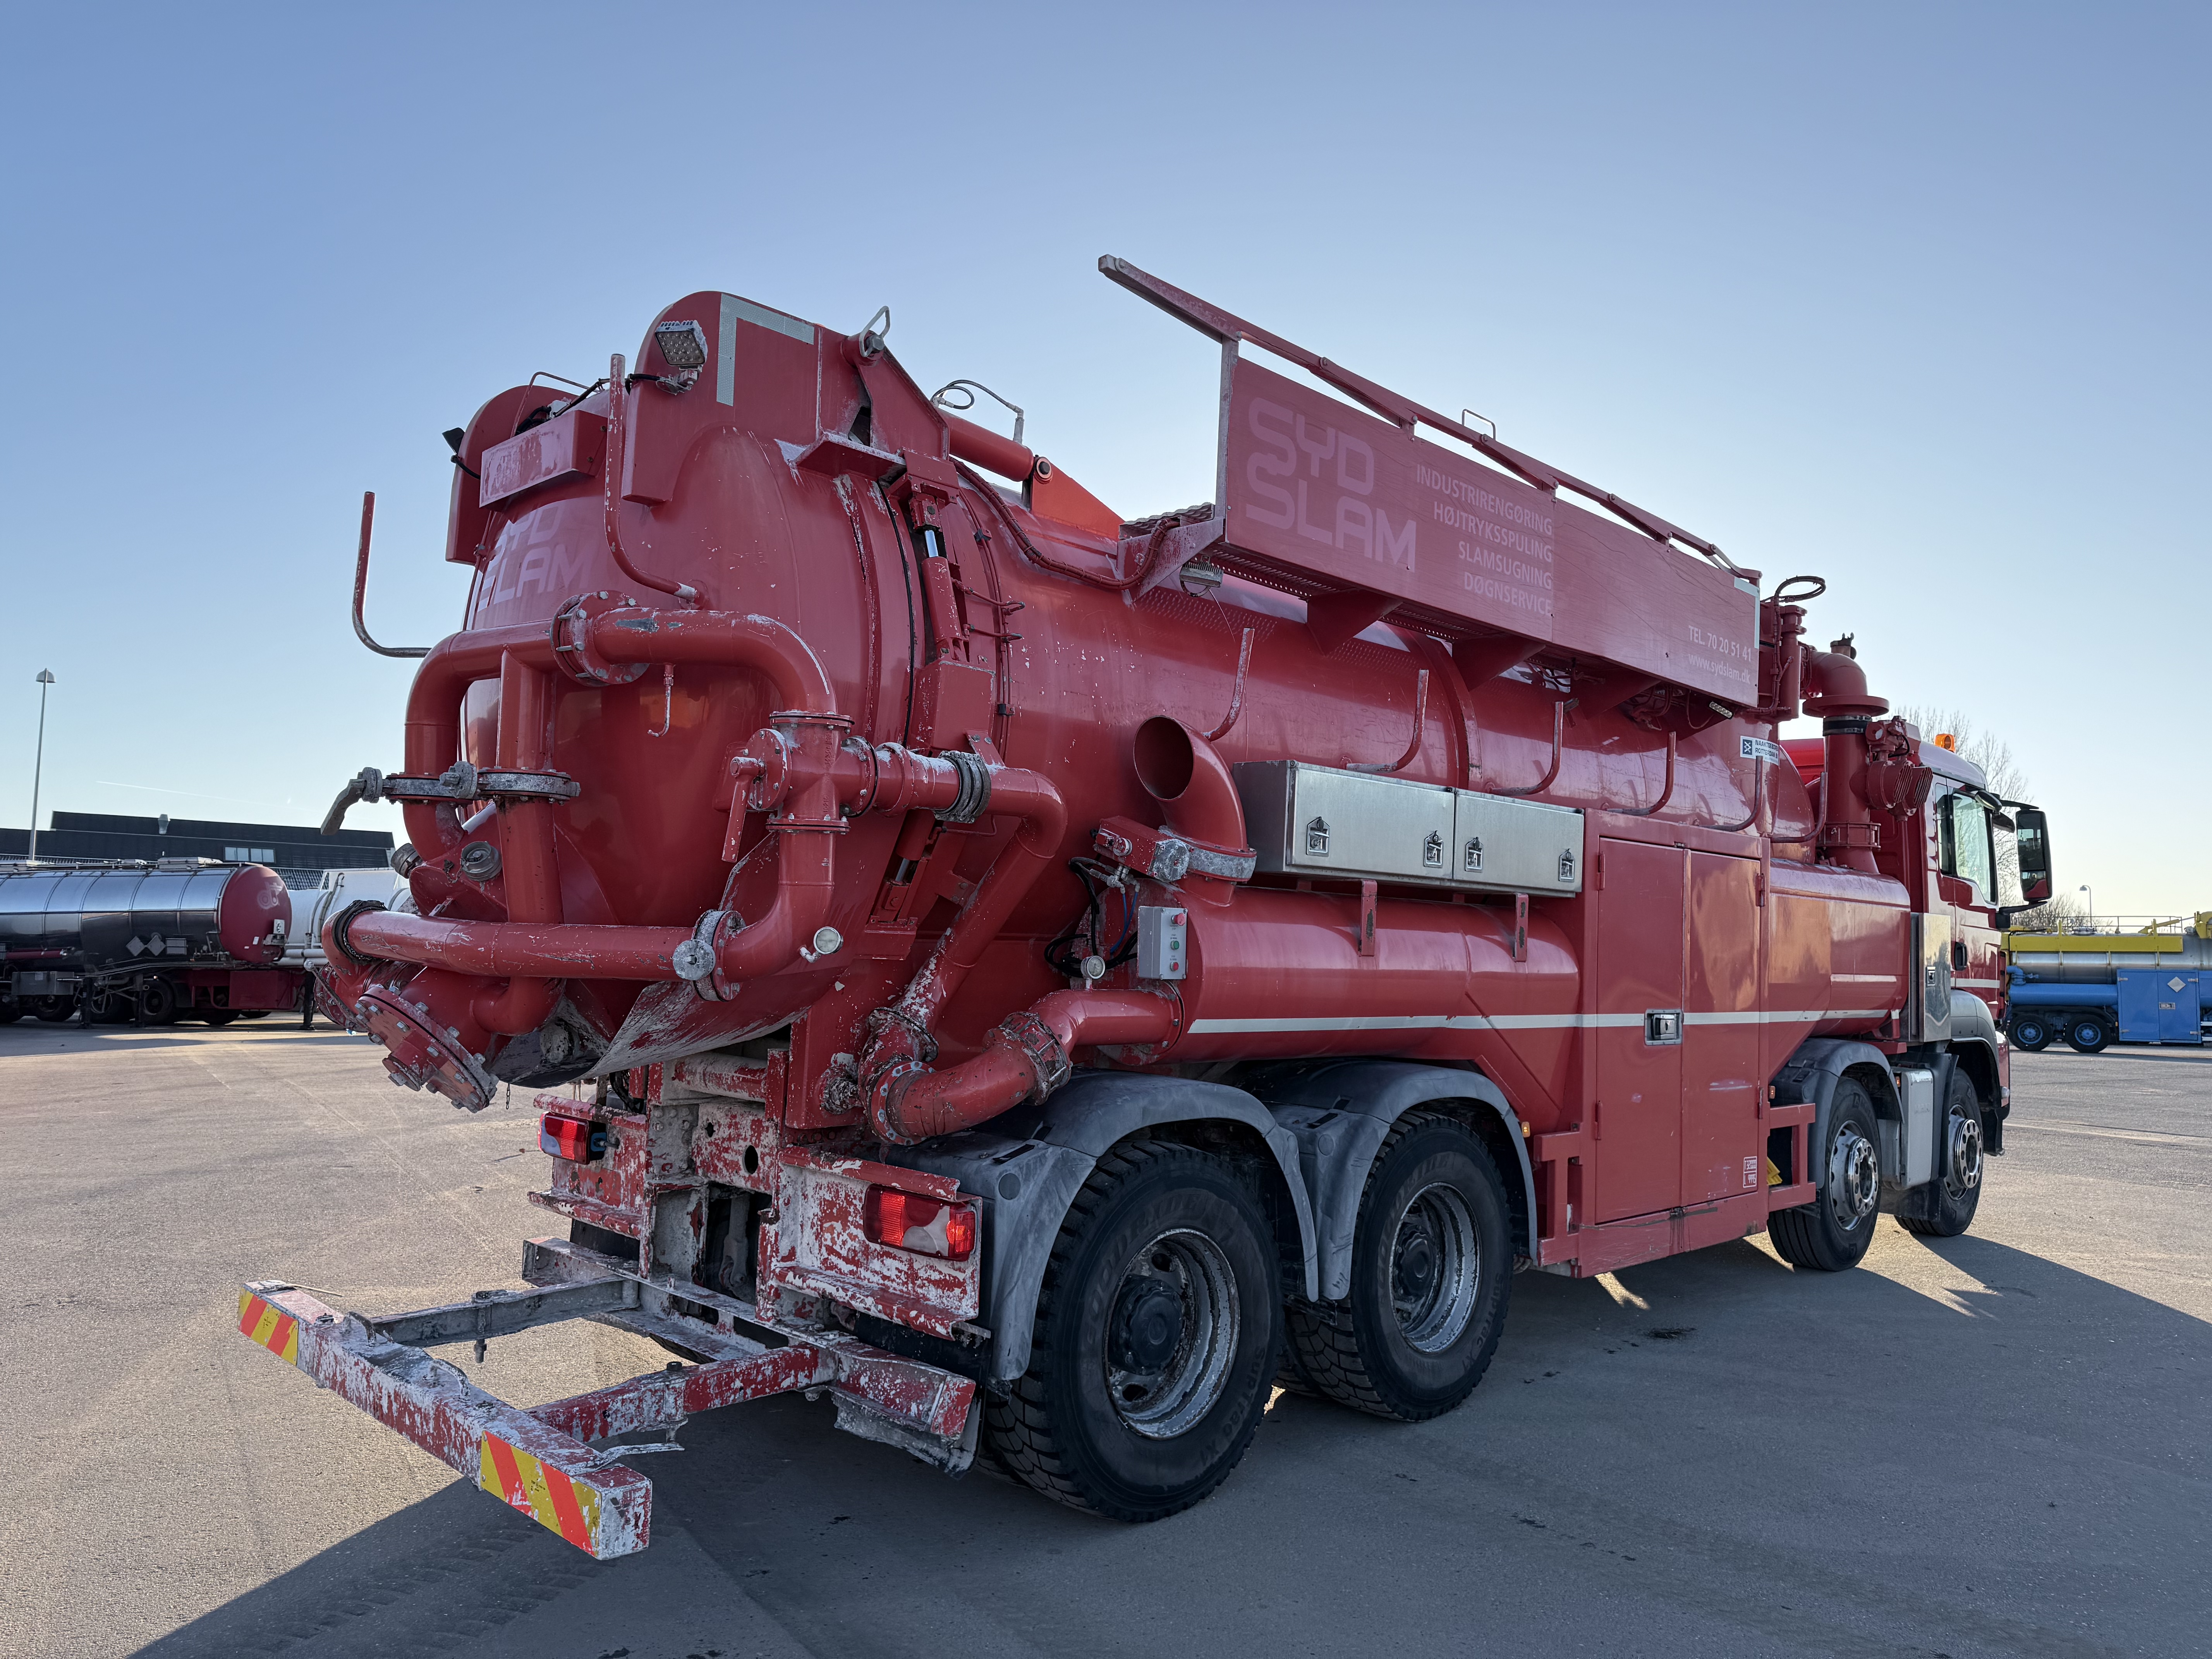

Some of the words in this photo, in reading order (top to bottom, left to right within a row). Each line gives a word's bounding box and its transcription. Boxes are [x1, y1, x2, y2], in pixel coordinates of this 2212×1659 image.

[1248, 397, 1374, 496] SYD
[1246, 452, 1417, 573] SLAM
[1417, 464, 1552, 536] INDUSTRIRENGØRING
[1434, 501, 1552, 563] HØJTRYKSSPULING
[1458, 542, 1552, 590] SLAMSUGNING
[1464, 571, 1552, 615] DØGNSERVICE
[1688, 654, 1750, 684] www.sydslam.dk
[1689, 625, 1705, 645] TEL.
[1707, 633, 1717, 649] 70
[1719, 637, 1729, 654] 20
[1731, 642, 1740, 658] 51
[1742, 646, 1751, 662] 41
